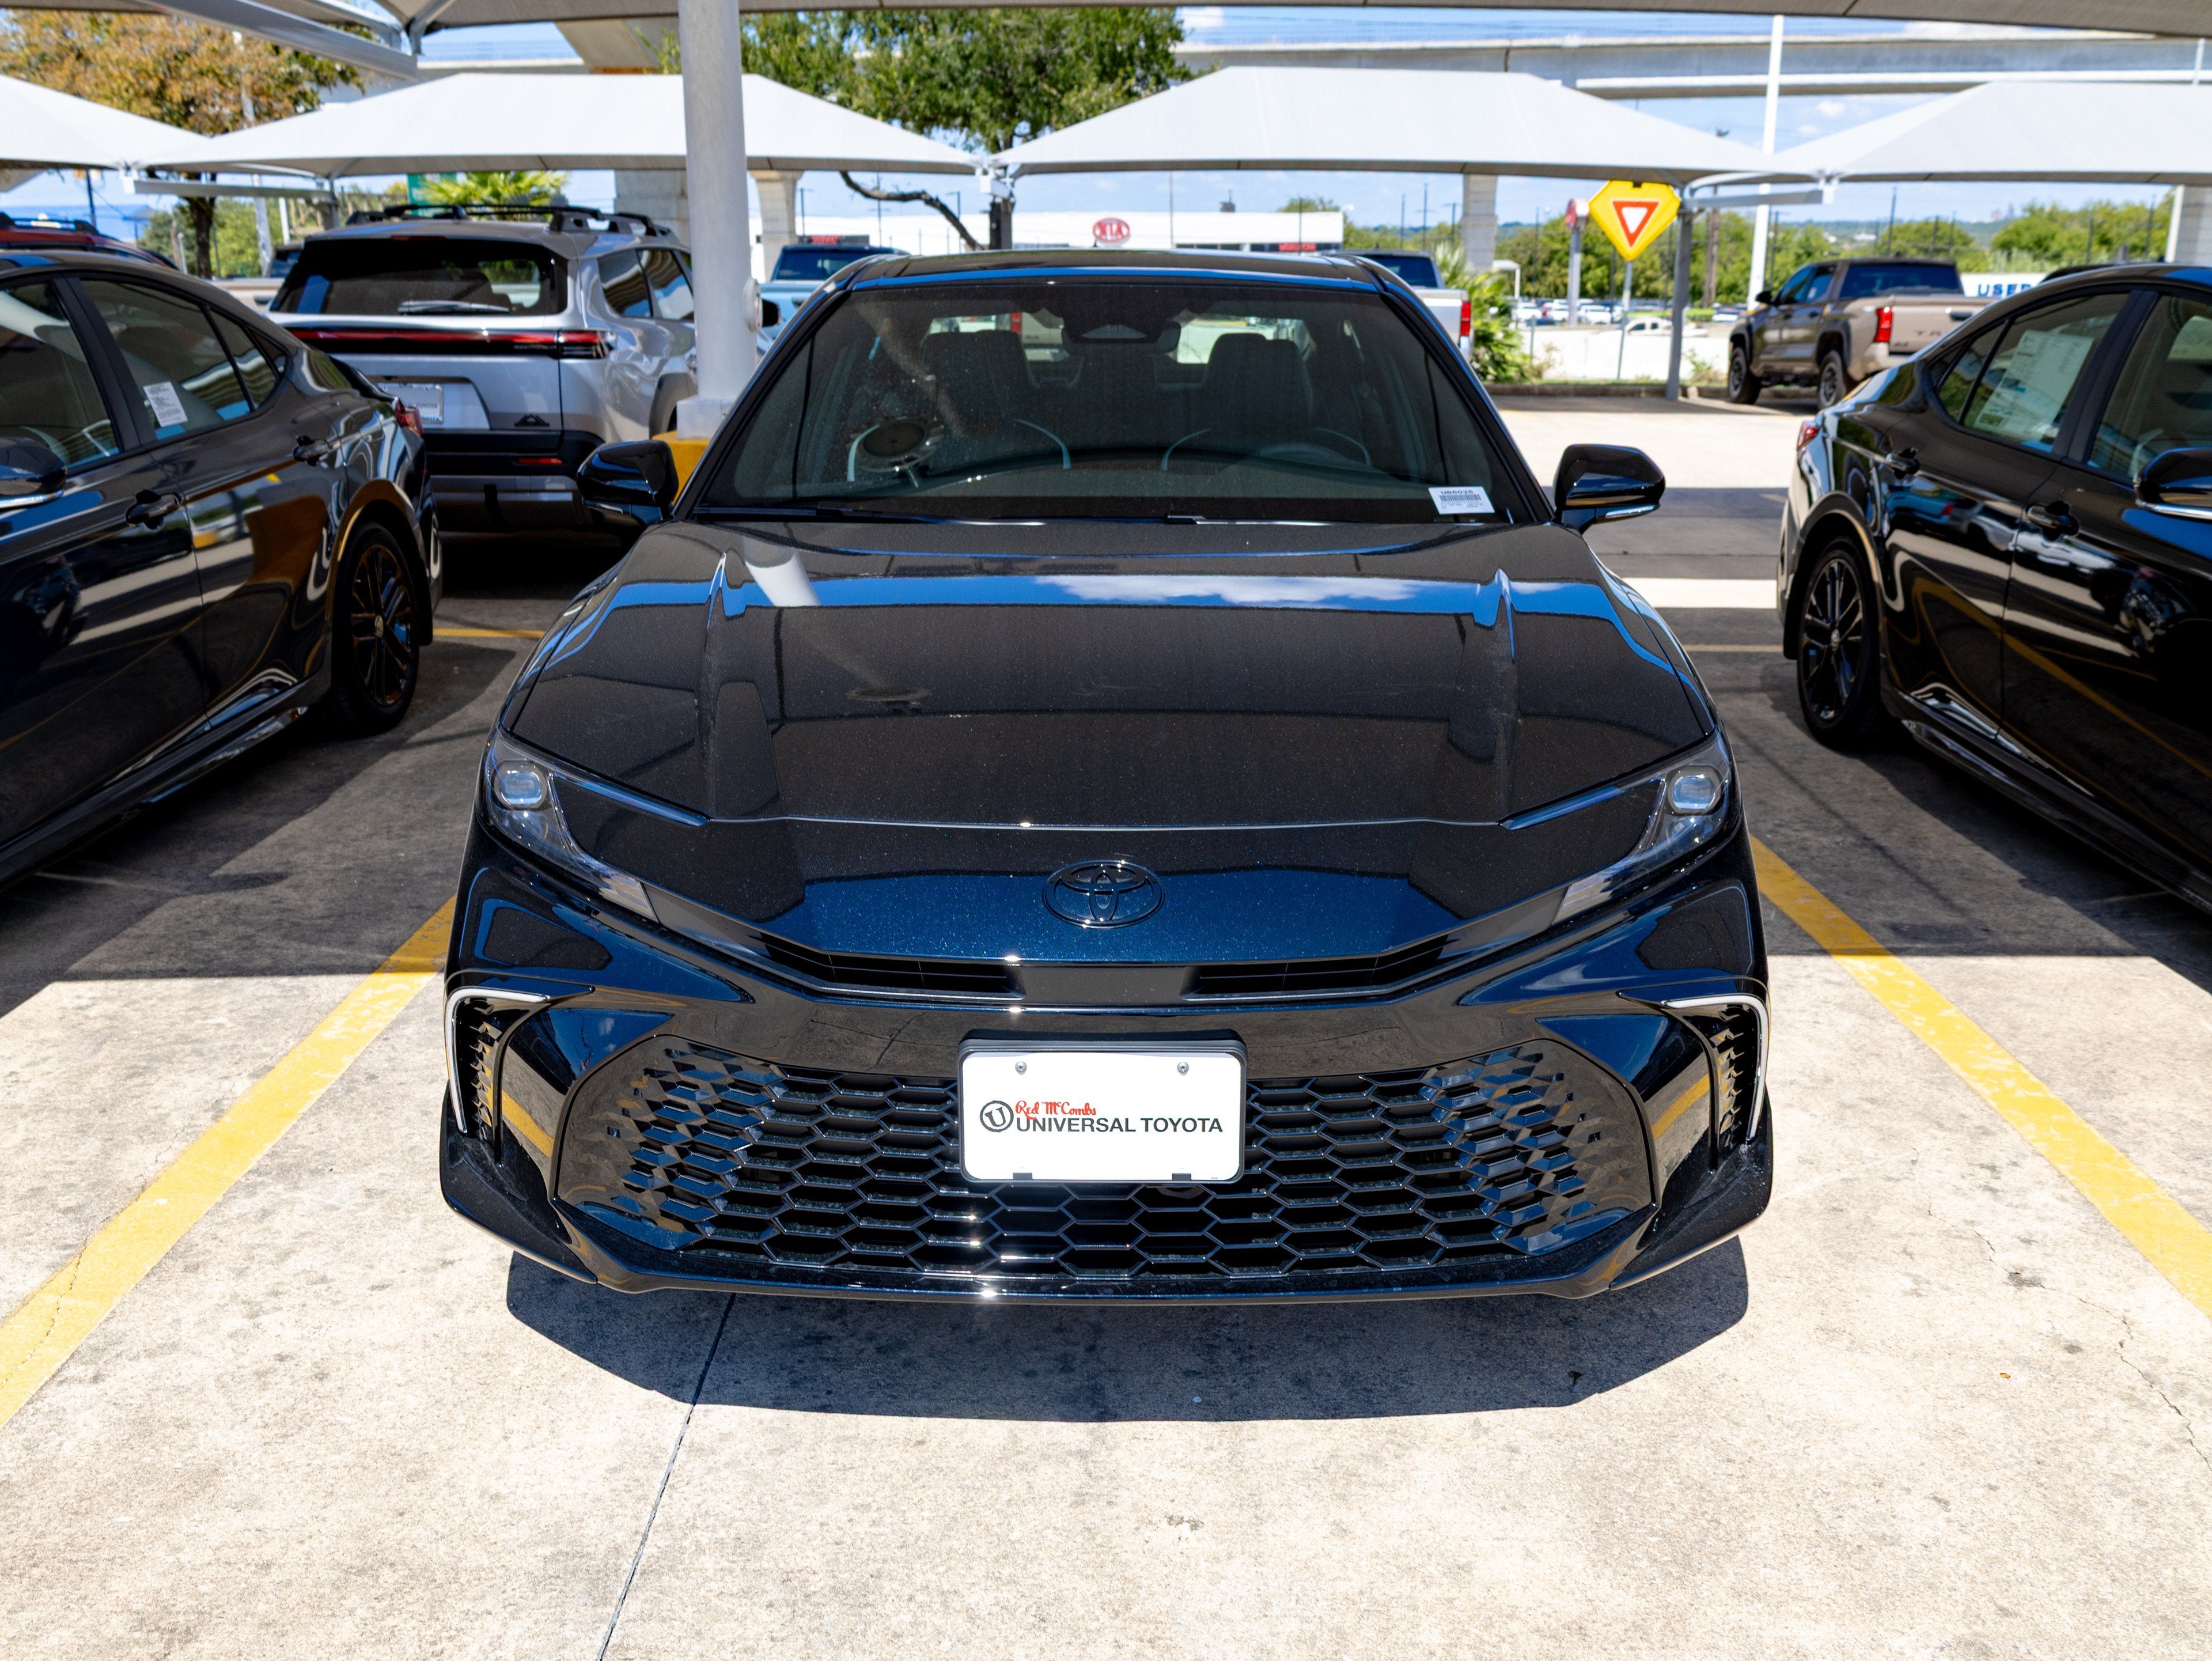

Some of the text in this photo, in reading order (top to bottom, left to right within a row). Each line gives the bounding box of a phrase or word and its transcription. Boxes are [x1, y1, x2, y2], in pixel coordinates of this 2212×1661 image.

[1015, 1100, 1096, 1120] Red McCombs
[1016, 1117, 1223, 1132] UNIVERSAL TOYOTA
